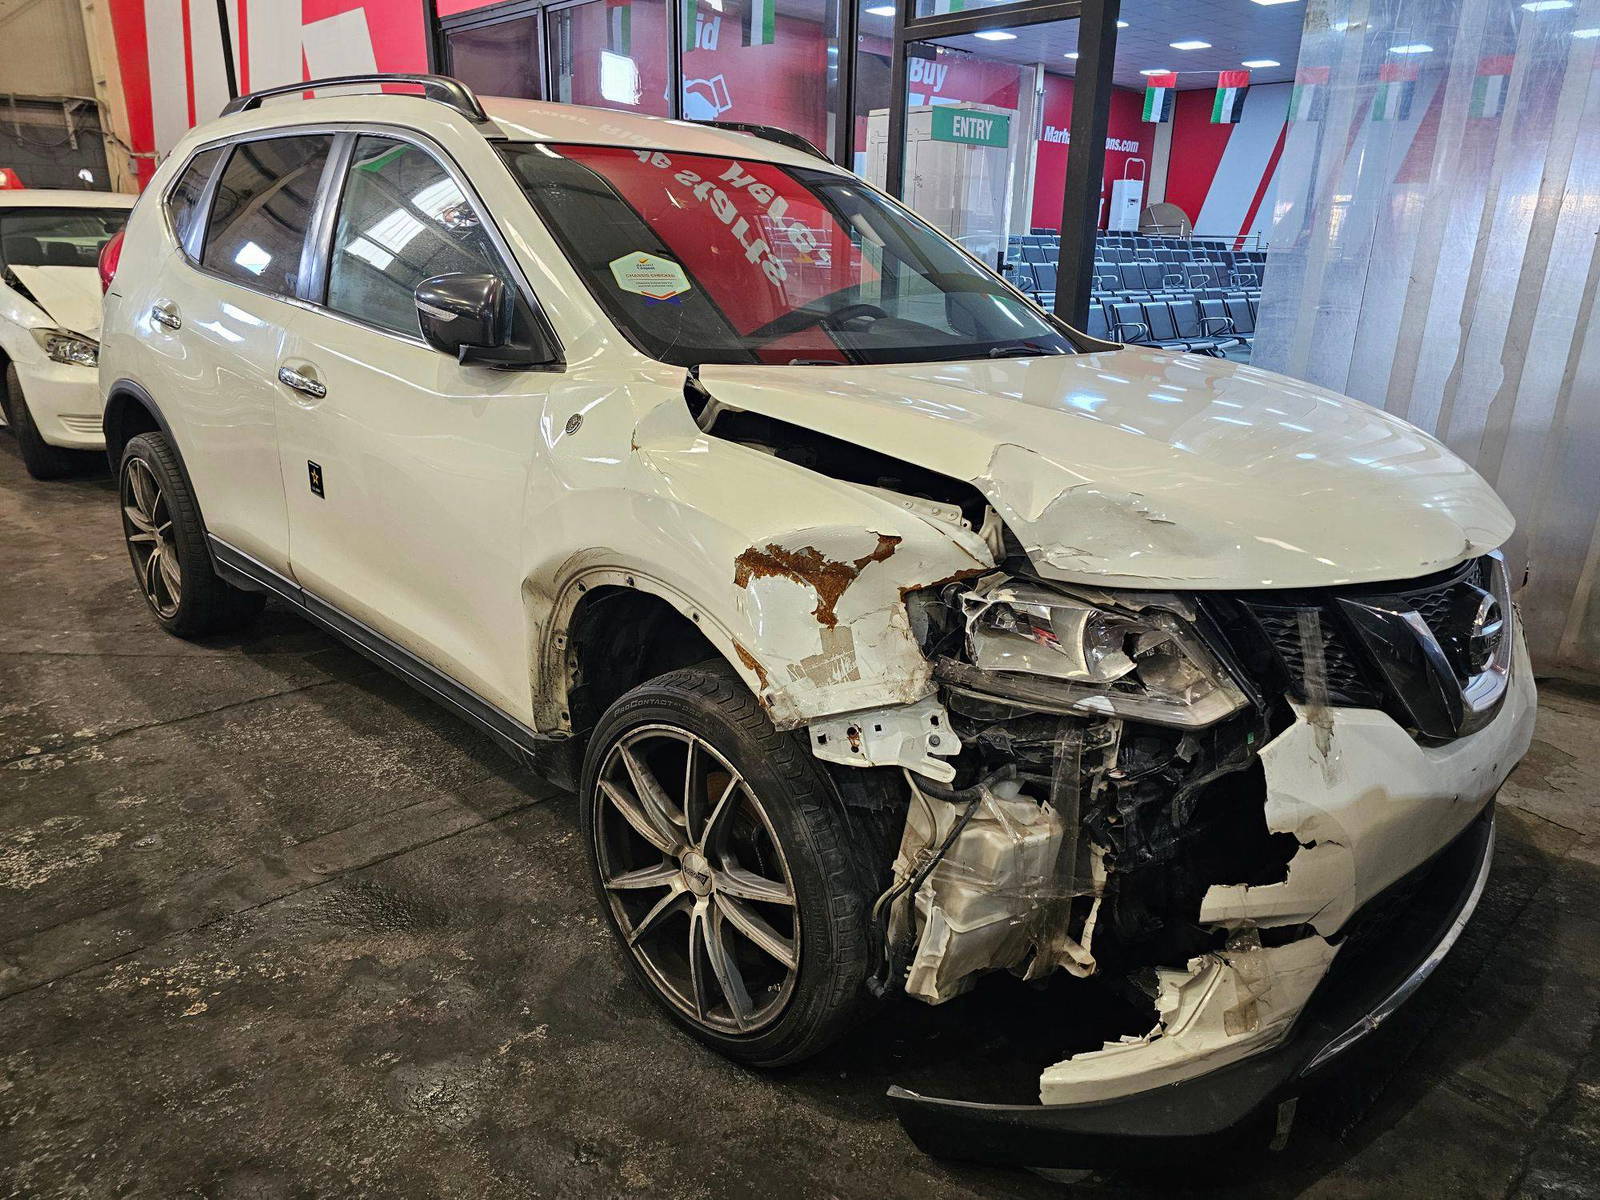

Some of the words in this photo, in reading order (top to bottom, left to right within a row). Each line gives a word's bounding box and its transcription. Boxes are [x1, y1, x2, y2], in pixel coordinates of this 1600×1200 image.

[694, 13, 721, 50] id
[909, 56, 949, 92] Buy
[952, 115, 993, 140] ENTRY
